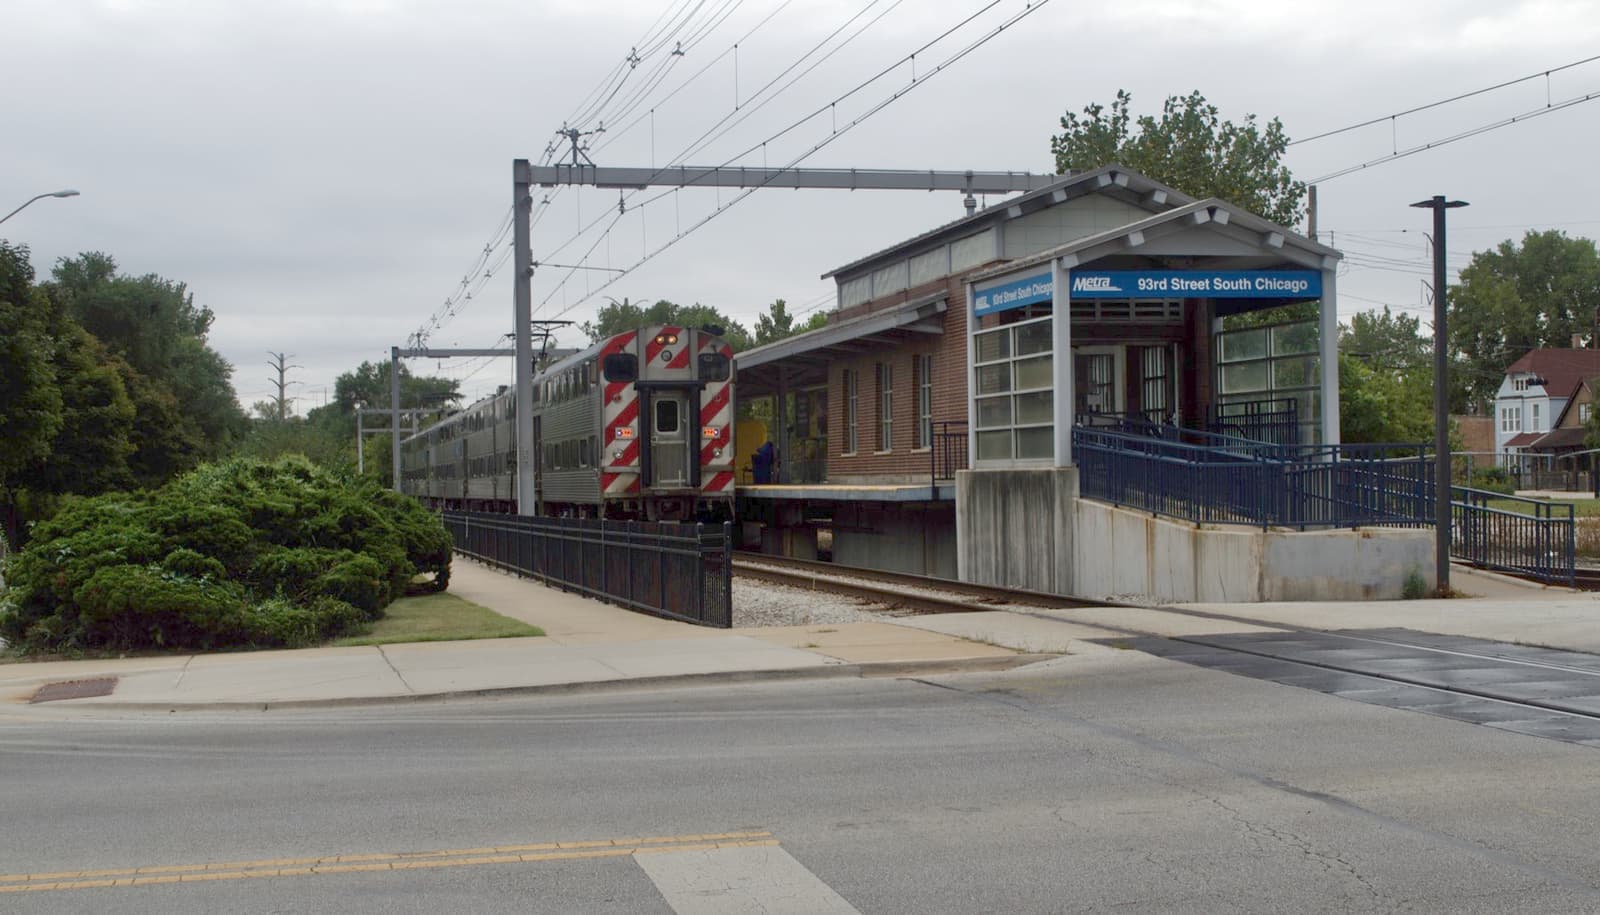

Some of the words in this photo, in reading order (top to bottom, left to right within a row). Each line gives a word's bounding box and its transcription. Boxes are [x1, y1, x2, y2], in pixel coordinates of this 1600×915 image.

[1073, 276, 1115, 291] Metra
[1138, 277, 1167, 290] 93rd
[1171, 277, 1210, 290] Street
[1213, 277, 1251, 290] South
[1255, 277, 1308, 292] Chicago
[1017, 285, 1033, 300] South
